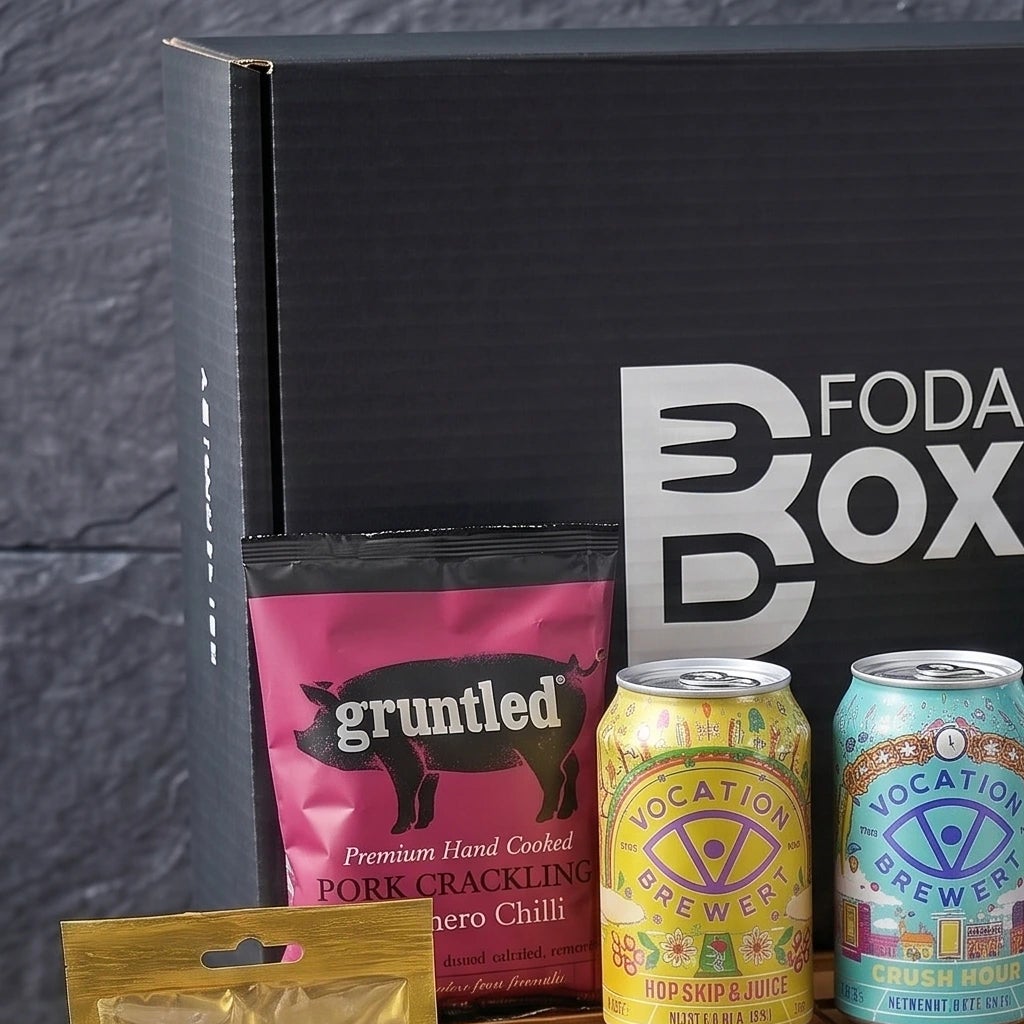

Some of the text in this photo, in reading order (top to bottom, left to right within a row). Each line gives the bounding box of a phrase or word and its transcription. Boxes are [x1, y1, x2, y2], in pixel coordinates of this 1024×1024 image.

[820, 367, 1024, 436] FODA
[629, 780, 789, 832] VOCATION
[868, 769, 1023, 818] VOCATION
[343, 831, 574, 867] Premium Hand Cooked
[316, 858, 593, 902] PORK CRACKLING
[495, 896, 566, 927] Chilli
[645, 975, 789, 1003] HOP SKIP & JUICE
[871, 961, 1021, 988] CRUSH HOUR
